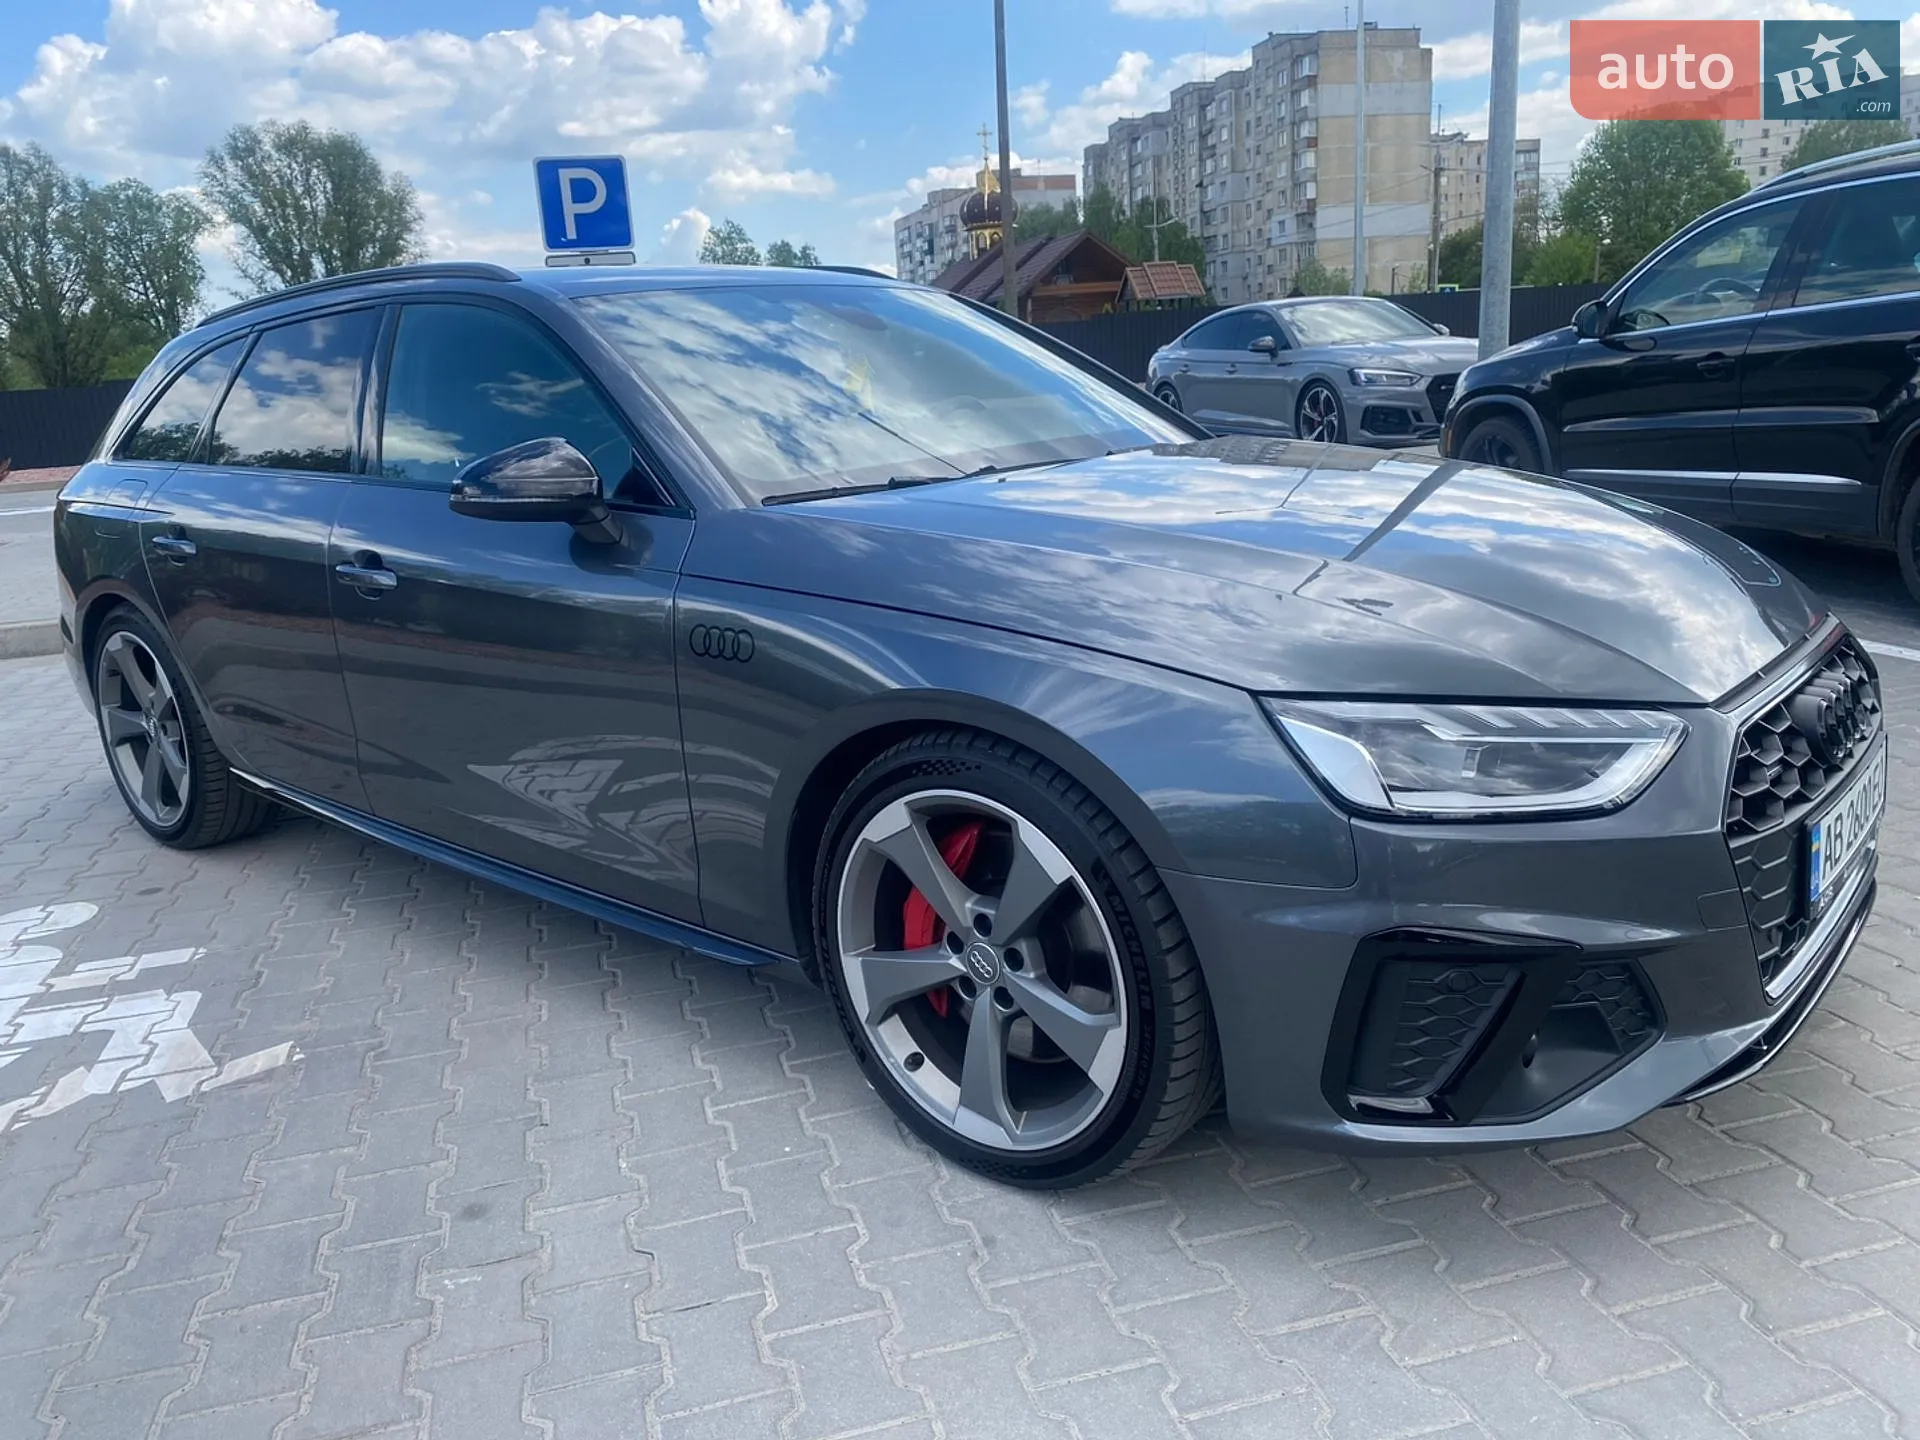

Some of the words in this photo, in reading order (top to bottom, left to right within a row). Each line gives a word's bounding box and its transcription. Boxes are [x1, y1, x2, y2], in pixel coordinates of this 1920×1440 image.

[557, 167, 607, 240] P
[1822, 812, 1843, 881] AB
[1109, 893, 1152, 1010] MICHELIN
